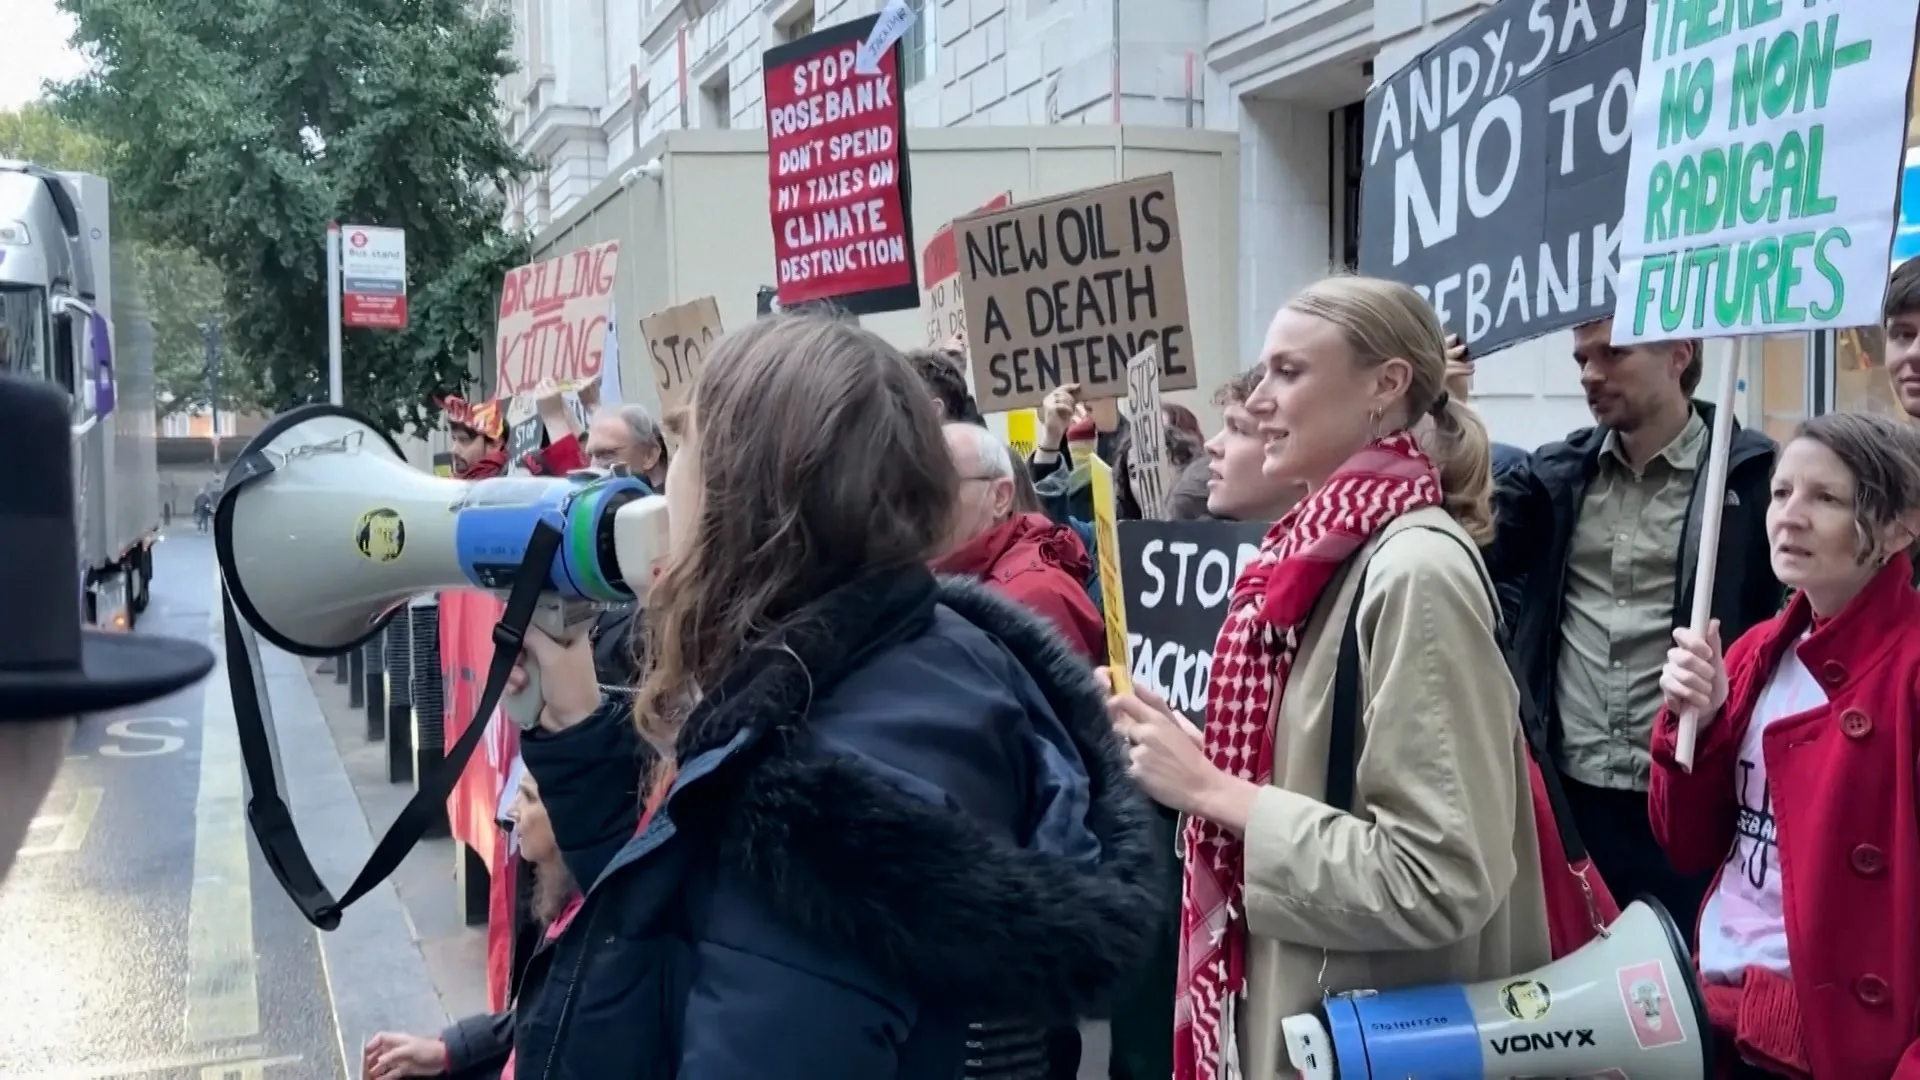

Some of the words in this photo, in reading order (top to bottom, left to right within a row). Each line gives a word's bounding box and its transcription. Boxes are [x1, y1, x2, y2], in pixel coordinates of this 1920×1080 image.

[793, 49, 855, 96] STOP
[1371, 18, 1513, 166] ANDY,
[1657, 57, 1714, 150] NO
[1728, 14, 1872, 131] NON-
[770, 75, 893, 139] ROSEBANK
[778, 140, 824, 176] DON'T
[829, 125, 893, 162] SPEND
[1393, 95, 1522, 266] NO
[1549, 67, 1638, 176] TO
[777, 183, 800, 212] MY
[806, 167, 864, 206] TAXES
[869, 159, 894, 189] ON
[1644, 124, 1837, 244] RADICAL
[784, 198, 887, 250] CLIMATE
[965, 213, 1047, 281] NEW
[1056, 203, 1120, 266] OIL
[1129, 190, 1171, 253] IS
[501, 243, 618, 319] DRILLING
[780, 235, 905, 283] DESTRUCTION
[1412, 223, 1624, 344] EBANK
[1633, 227, 1852, 336] FUTURES
[984, 296, 1012, 344] A
[1025, 265, 1157, 338] DEATH
[1129, 357, 1156, 416] STOP
[515, 419, 537, 448] STOP
[1132, 412, 1161, 466] NEW
[1490, 1029, 1596, 1056] VONYX
